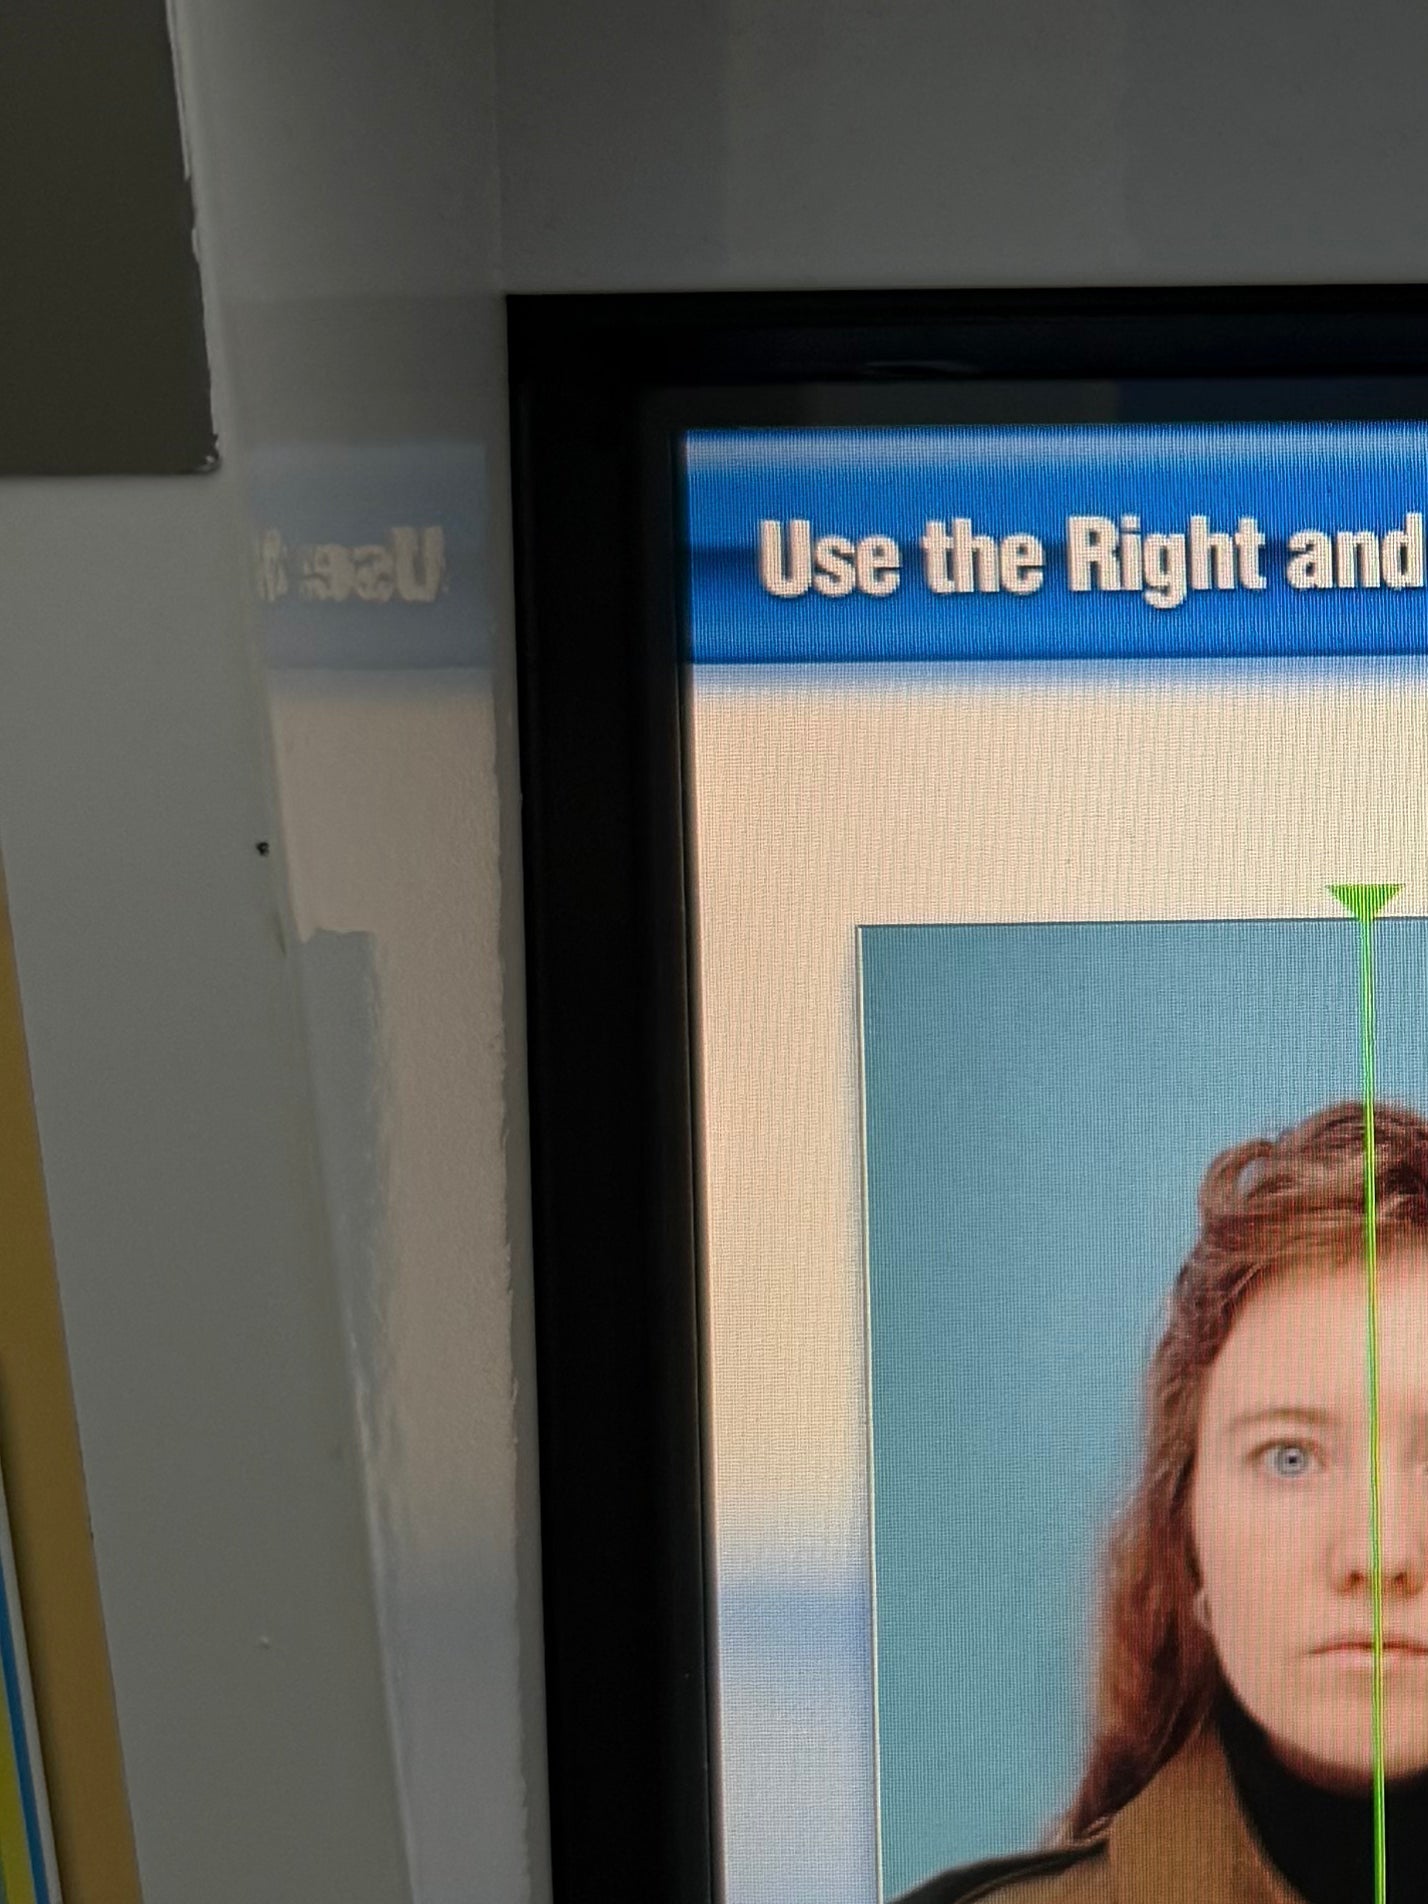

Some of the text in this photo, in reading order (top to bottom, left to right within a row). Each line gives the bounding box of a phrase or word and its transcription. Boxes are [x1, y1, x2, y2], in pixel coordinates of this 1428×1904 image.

[760, 518, 901, 597] Use
[922, 518, 1044, 594] the
[1067, 515, 1267, 609] Right
[1286, 512, 1424, 590] and
